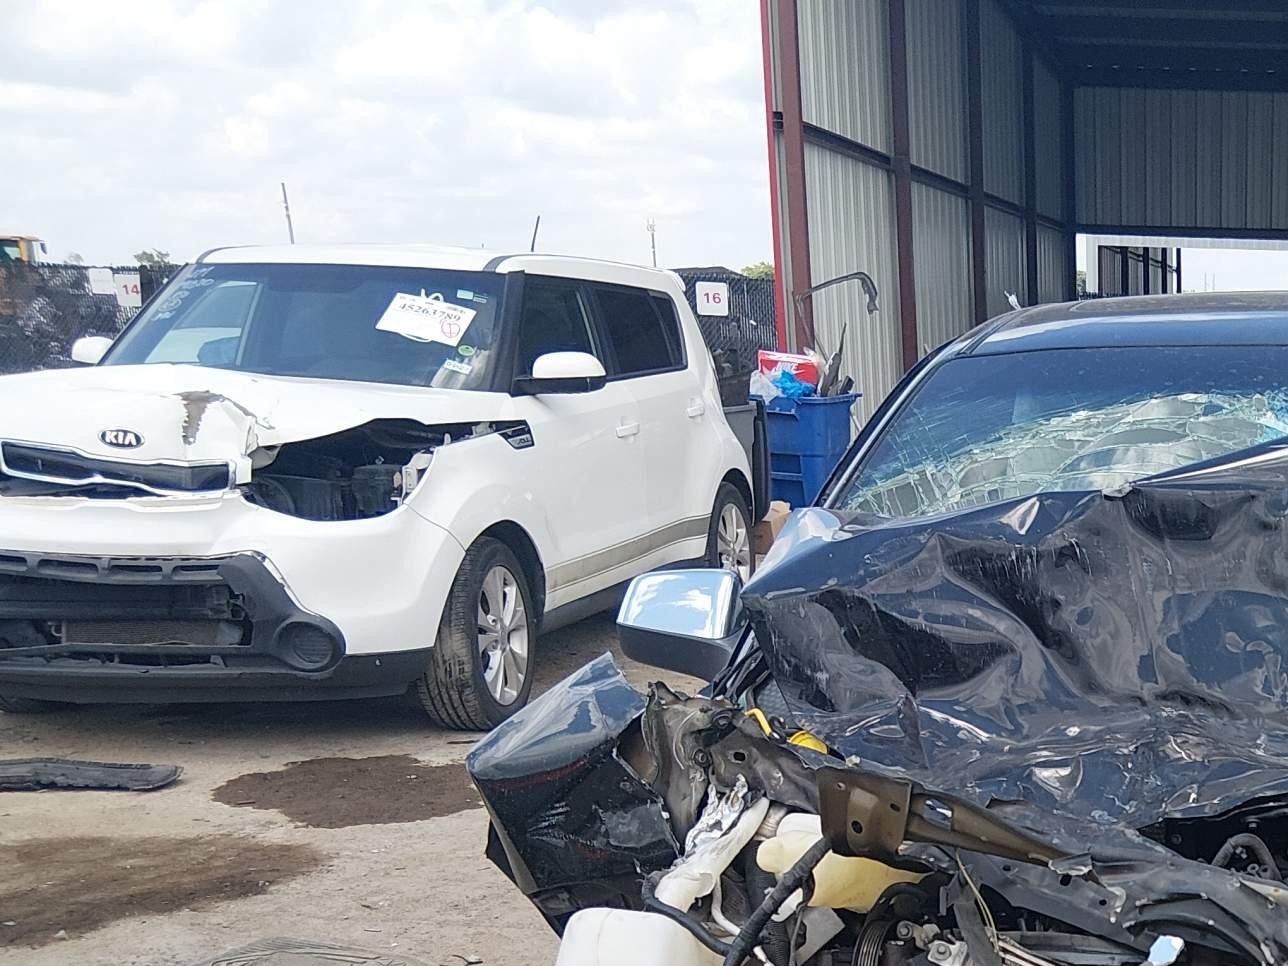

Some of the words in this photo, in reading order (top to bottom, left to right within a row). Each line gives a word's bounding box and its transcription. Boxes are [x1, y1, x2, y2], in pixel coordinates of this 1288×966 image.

[122, 284, 140, 296] 14
[703, 292, 722, 304] 16
[105, 430, 137, 446] KIA
